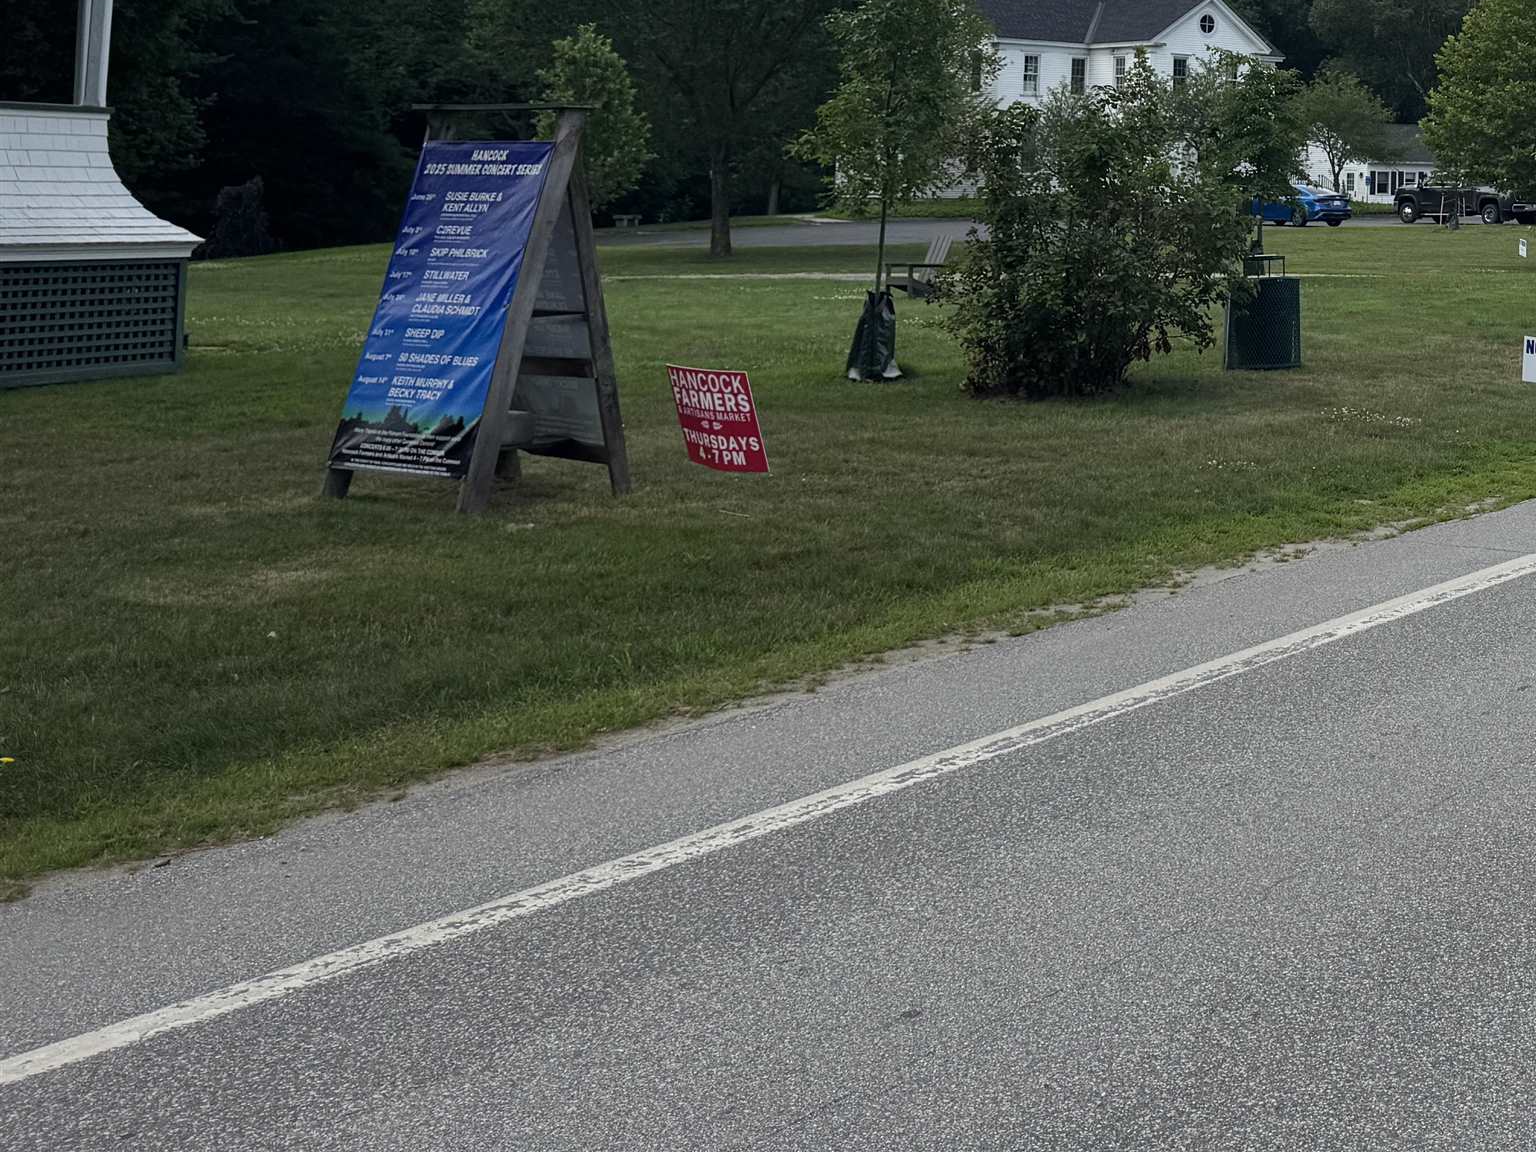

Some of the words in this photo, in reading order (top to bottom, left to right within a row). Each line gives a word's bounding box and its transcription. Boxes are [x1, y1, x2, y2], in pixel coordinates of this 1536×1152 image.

[471, 150, 509, 161] HANCOCK
[424, 163, 447, 175] 2025
[446, 163, 480, 175] SUMMER
[481, 164, 516, 176] CONCERT
[445, 192, 468, 201] SUSIE
[442, 203, 463, 212] KENT
[463, 203, 489, 213] ALLYN
[430, 248, 449, 257] SKIP
[448, 248, 488, 258] PHILBRICK
[423, 270, 470, 281] STILLWATER
[405, 328, 431, 338] SHEEP
[431, 329, 445, 339] DIP
[409, 353, 440, 364] SHADES
[440, 355, 453, 365] OF
[452, 356, 479, 367] BLUES
[668, 369, 745, 393] HANCOCK
[388, 388, 415, 398] BECKY
[416, 389, 442, 400] TRACY
[673, 386, 751, 412] FARMERS
[683, 407, 715, 420] ARTISANS
[716, 412, 751, 422] MARKET
[683, 428, 760, 451] THURSDAYS
